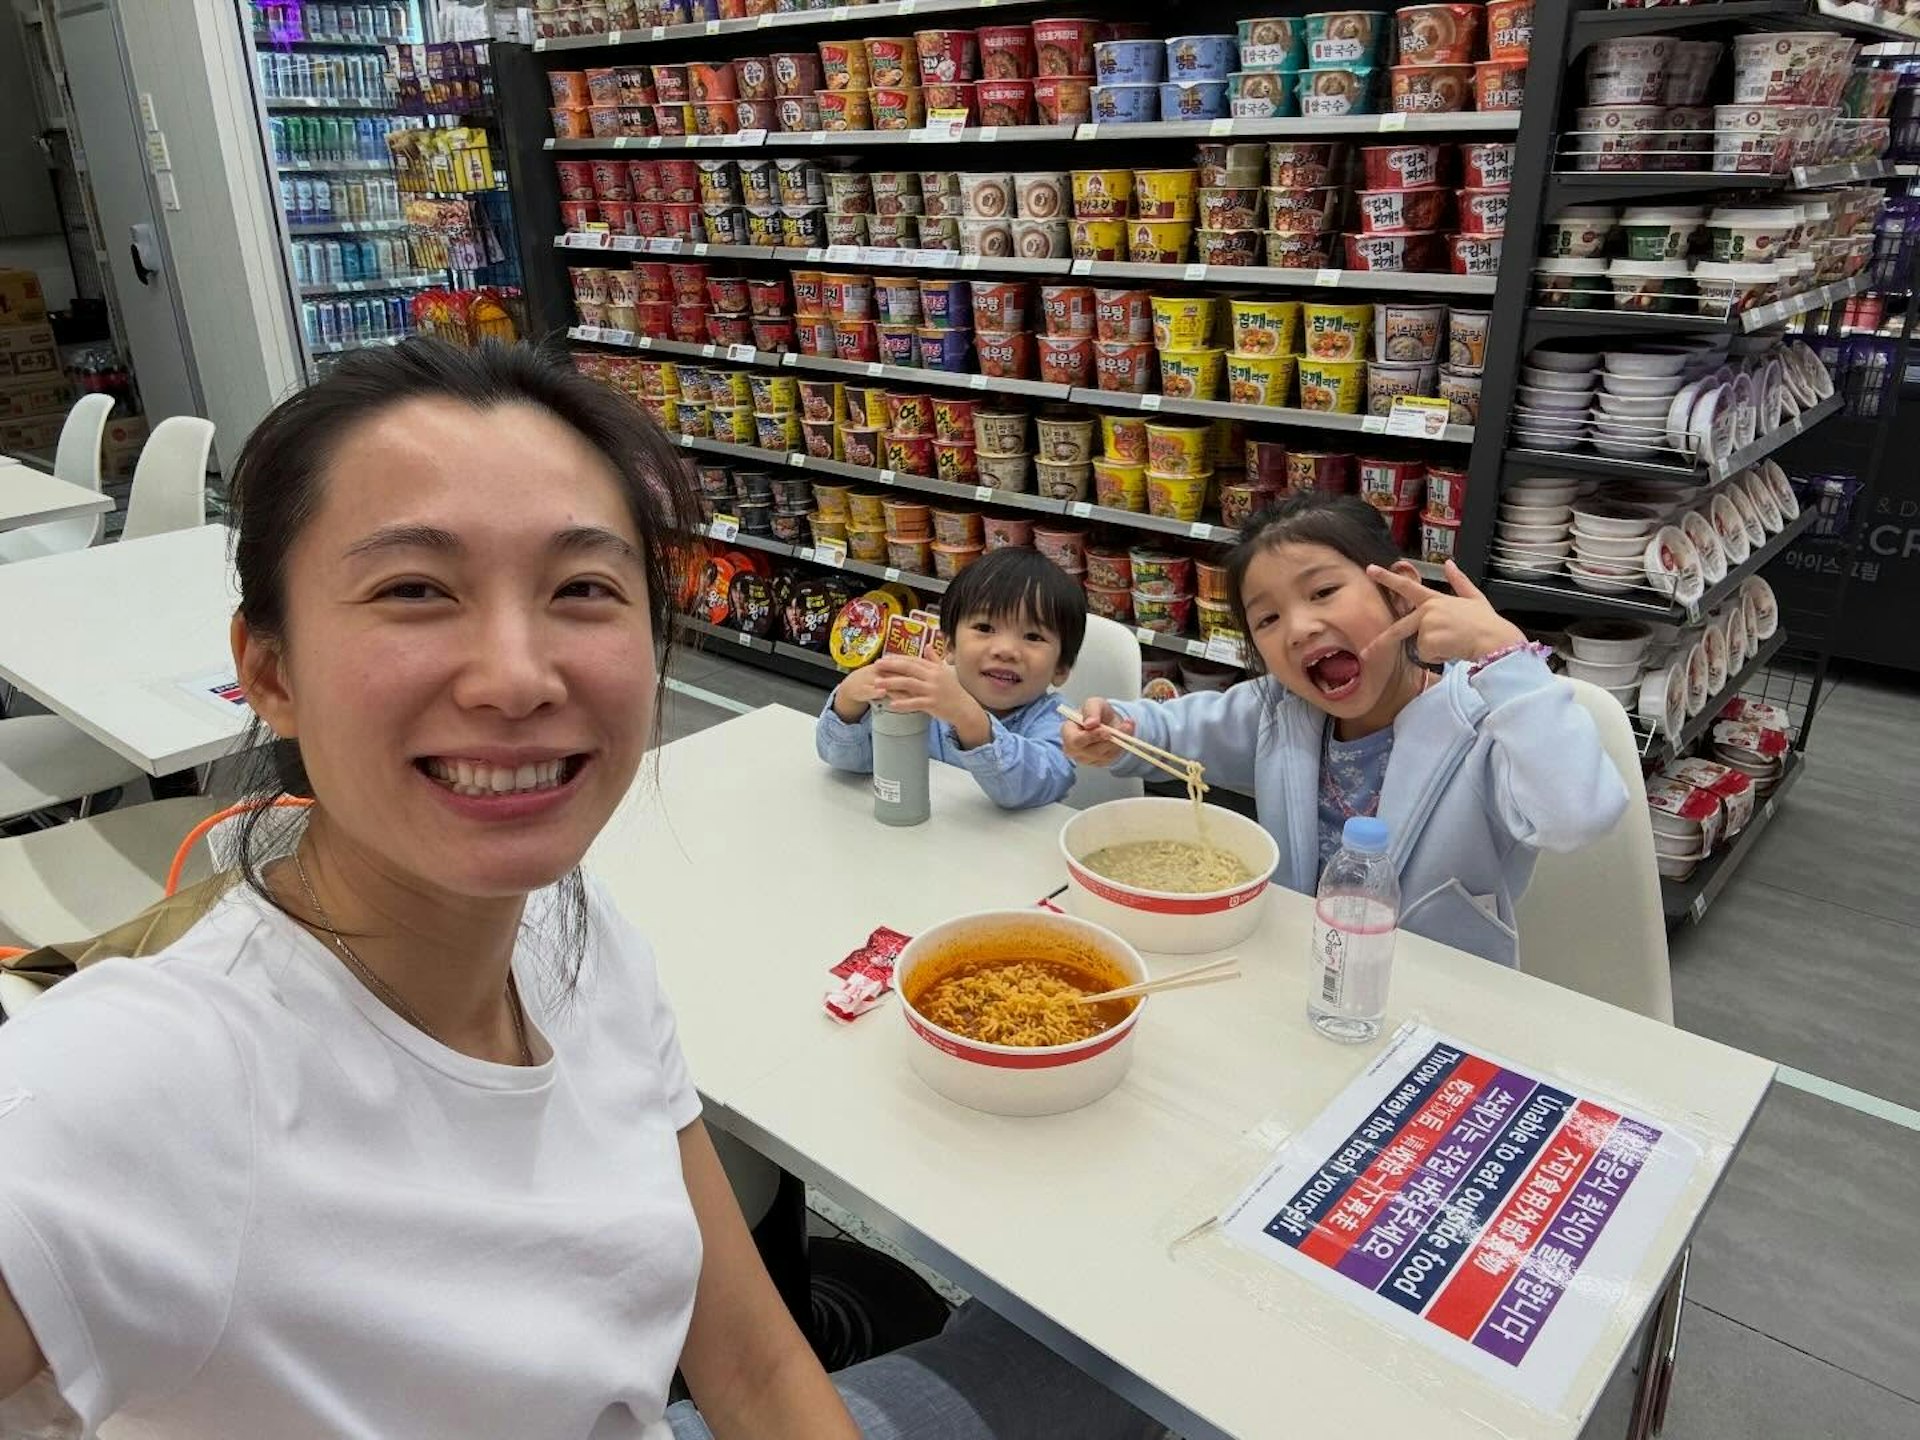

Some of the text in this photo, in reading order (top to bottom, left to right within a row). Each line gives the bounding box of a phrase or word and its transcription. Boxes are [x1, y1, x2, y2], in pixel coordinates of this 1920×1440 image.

[1405, 151, 1429, 167] 김치
[1483, 150, 1508, 166] 김치
[1372, 197, 1393, 211] 김치
[1371, 242, 1393, 256] 김치
[1467, 243, 1491, 258] 김치
[1239, 313, 1283, 329] 참깨라면
[1313, 315, 1360, 332] 참깨라면
[982, 346, 1013, 361] 새우탕
[1046, 352, 1081, 368] 새우탕
[1415, 1048, 1460, 1087] Throw
[1380, 1082, 1421, 1117] away
[1361, 1114, 1395, 1141] the
[1333, 1136, 1374, 1176] trash
[1361, 1085, 1515, 1260] 쓰레기는 직접 버려주세요
[1271, 1170, 1339, 1237] yourself.
[1390, 1093, 1564, 1299] Unable to eat outside food
[1549, 1188, 1609, 1250] 취식이
